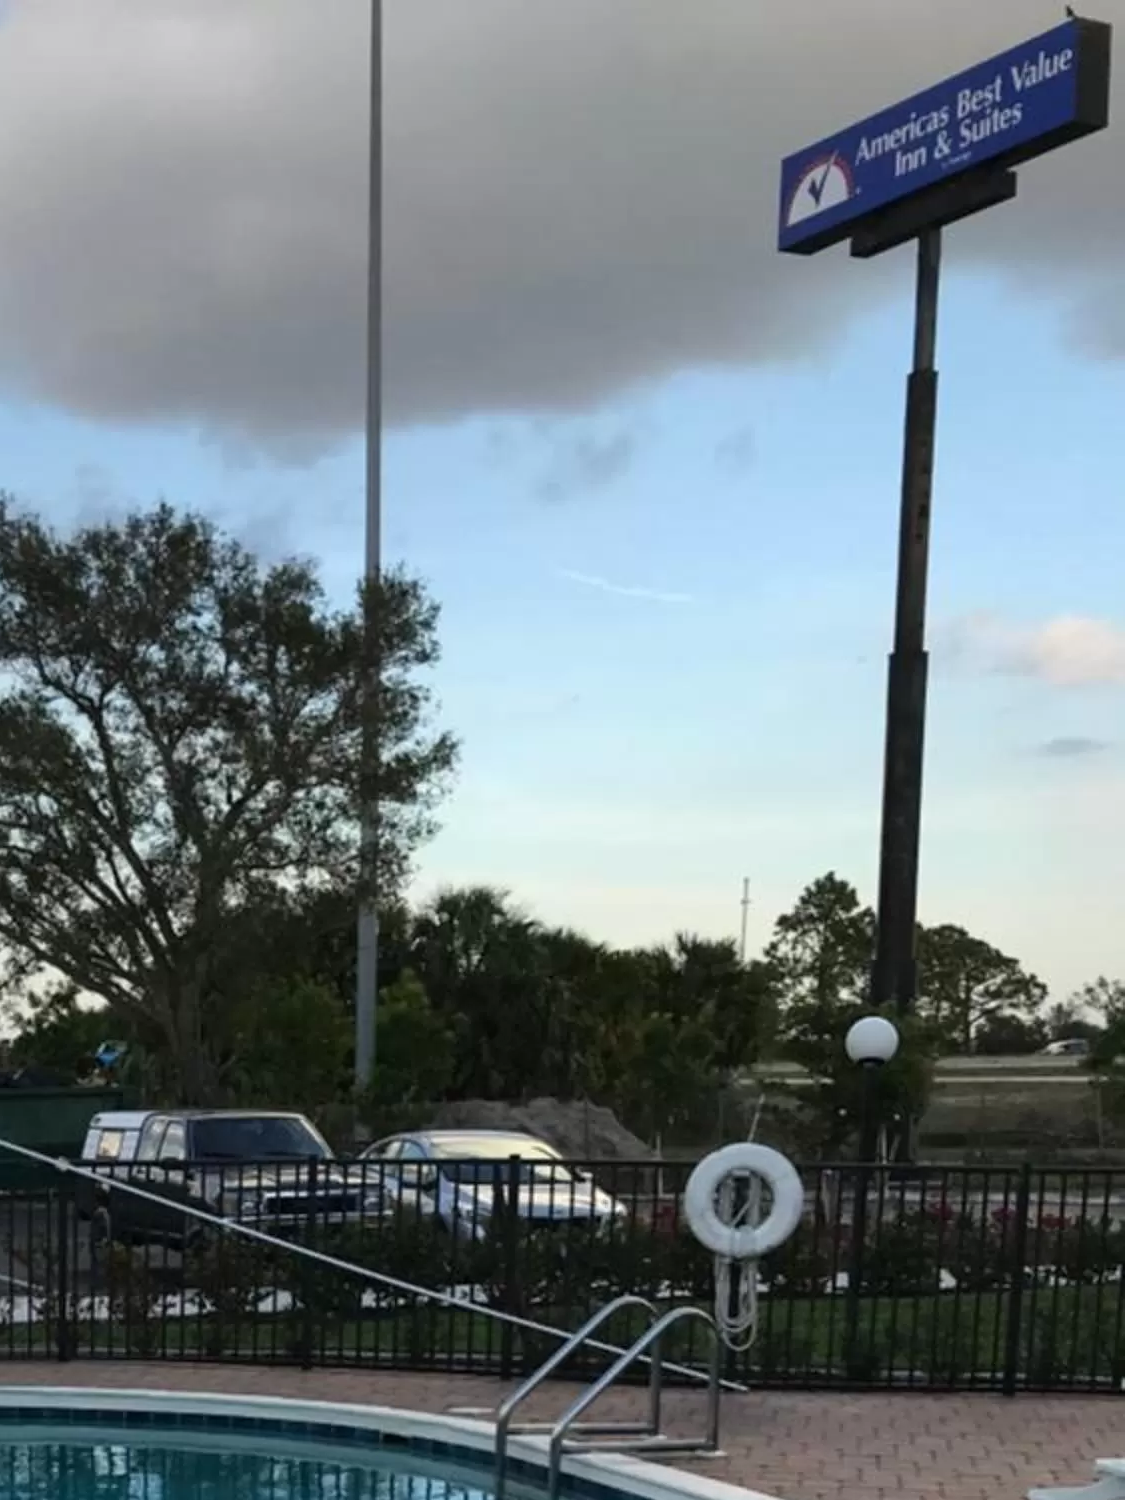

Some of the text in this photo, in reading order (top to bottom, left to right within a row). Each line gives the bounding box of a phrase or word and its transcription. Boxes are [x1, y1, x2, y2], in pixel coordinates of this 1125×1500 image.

[855, 104, 949, 166] Americas
[956, 75, 1003, 119] Best
[1011, 48, 1073, 93] Value
[894, 143, 926, 177] Inn
[934, 130, 953, 160] &
[959, 101, 1023, 149] Suites
